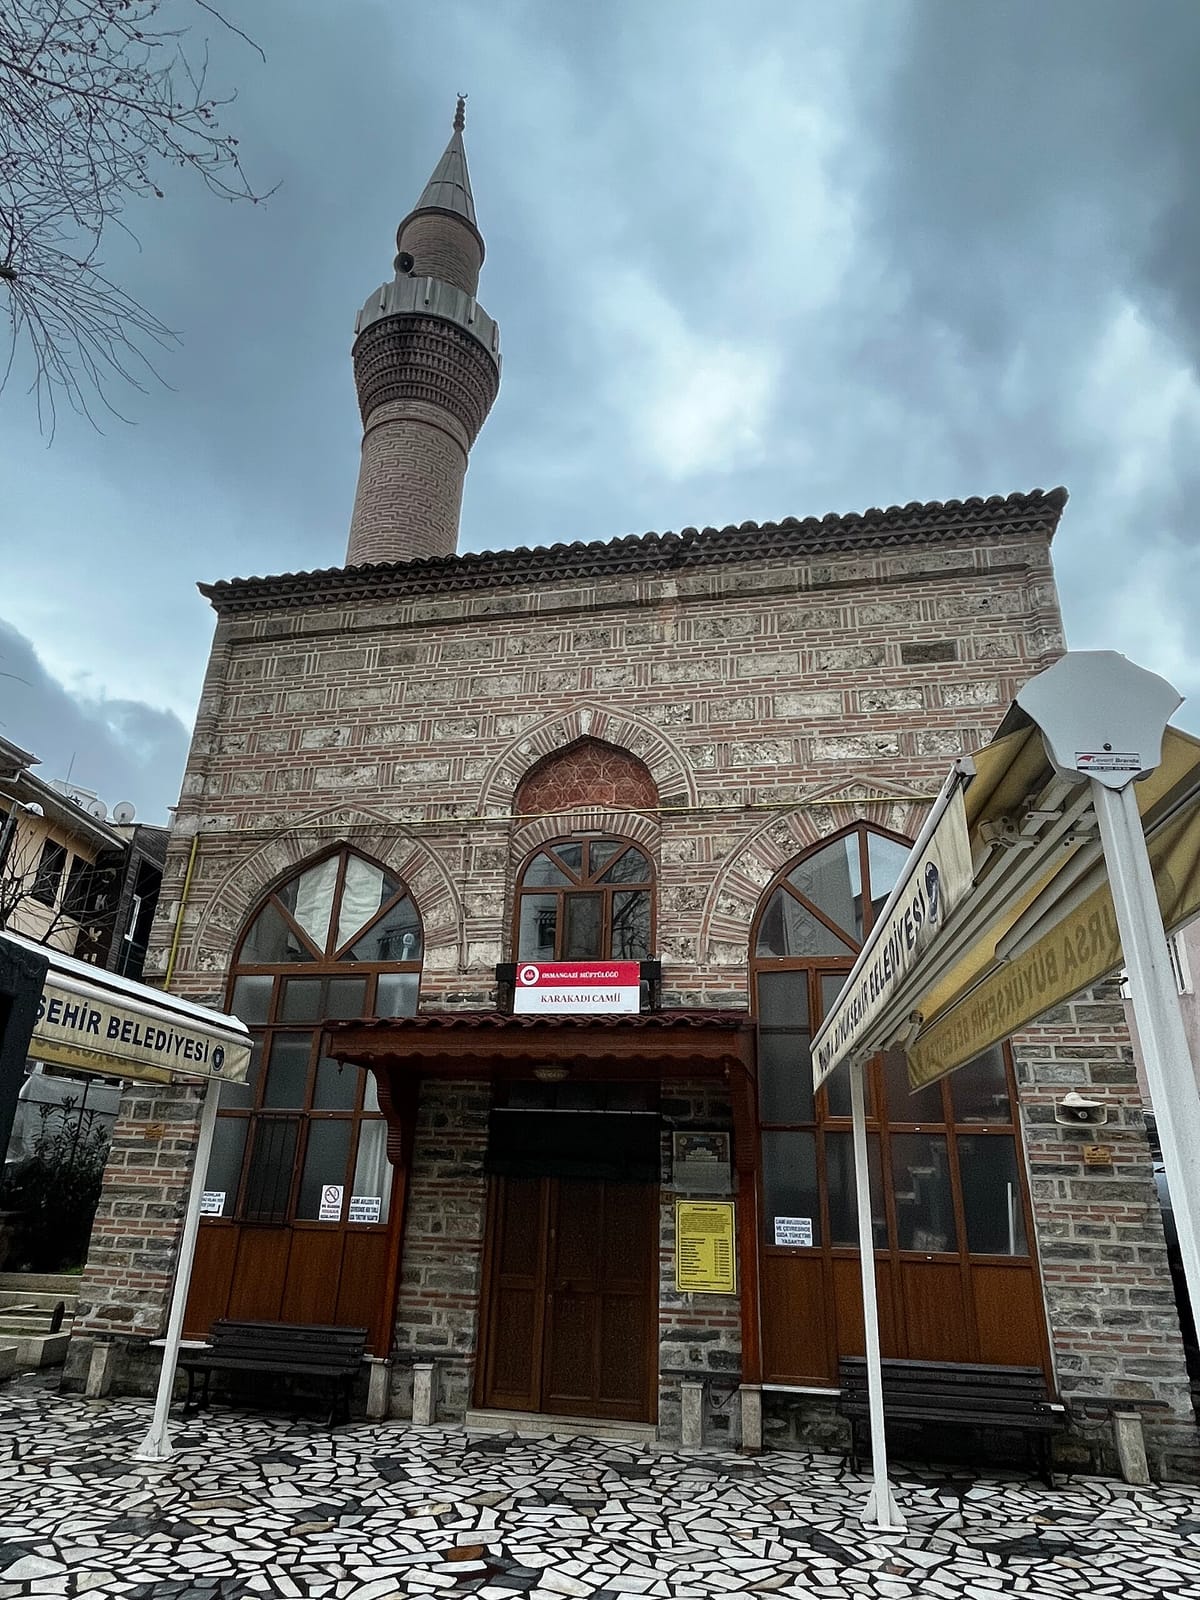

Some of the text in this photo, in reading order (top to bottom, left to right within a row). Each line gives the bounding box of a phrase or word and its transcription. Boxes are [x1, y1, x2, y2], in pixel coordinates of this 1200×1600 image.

[869, 878, 925, 1003] BELEDİYESİ
[540, 992, 621, 1004] KARAKADI CAMİİ
[107, 1016, 209, 1063] BELEDİYESİ
